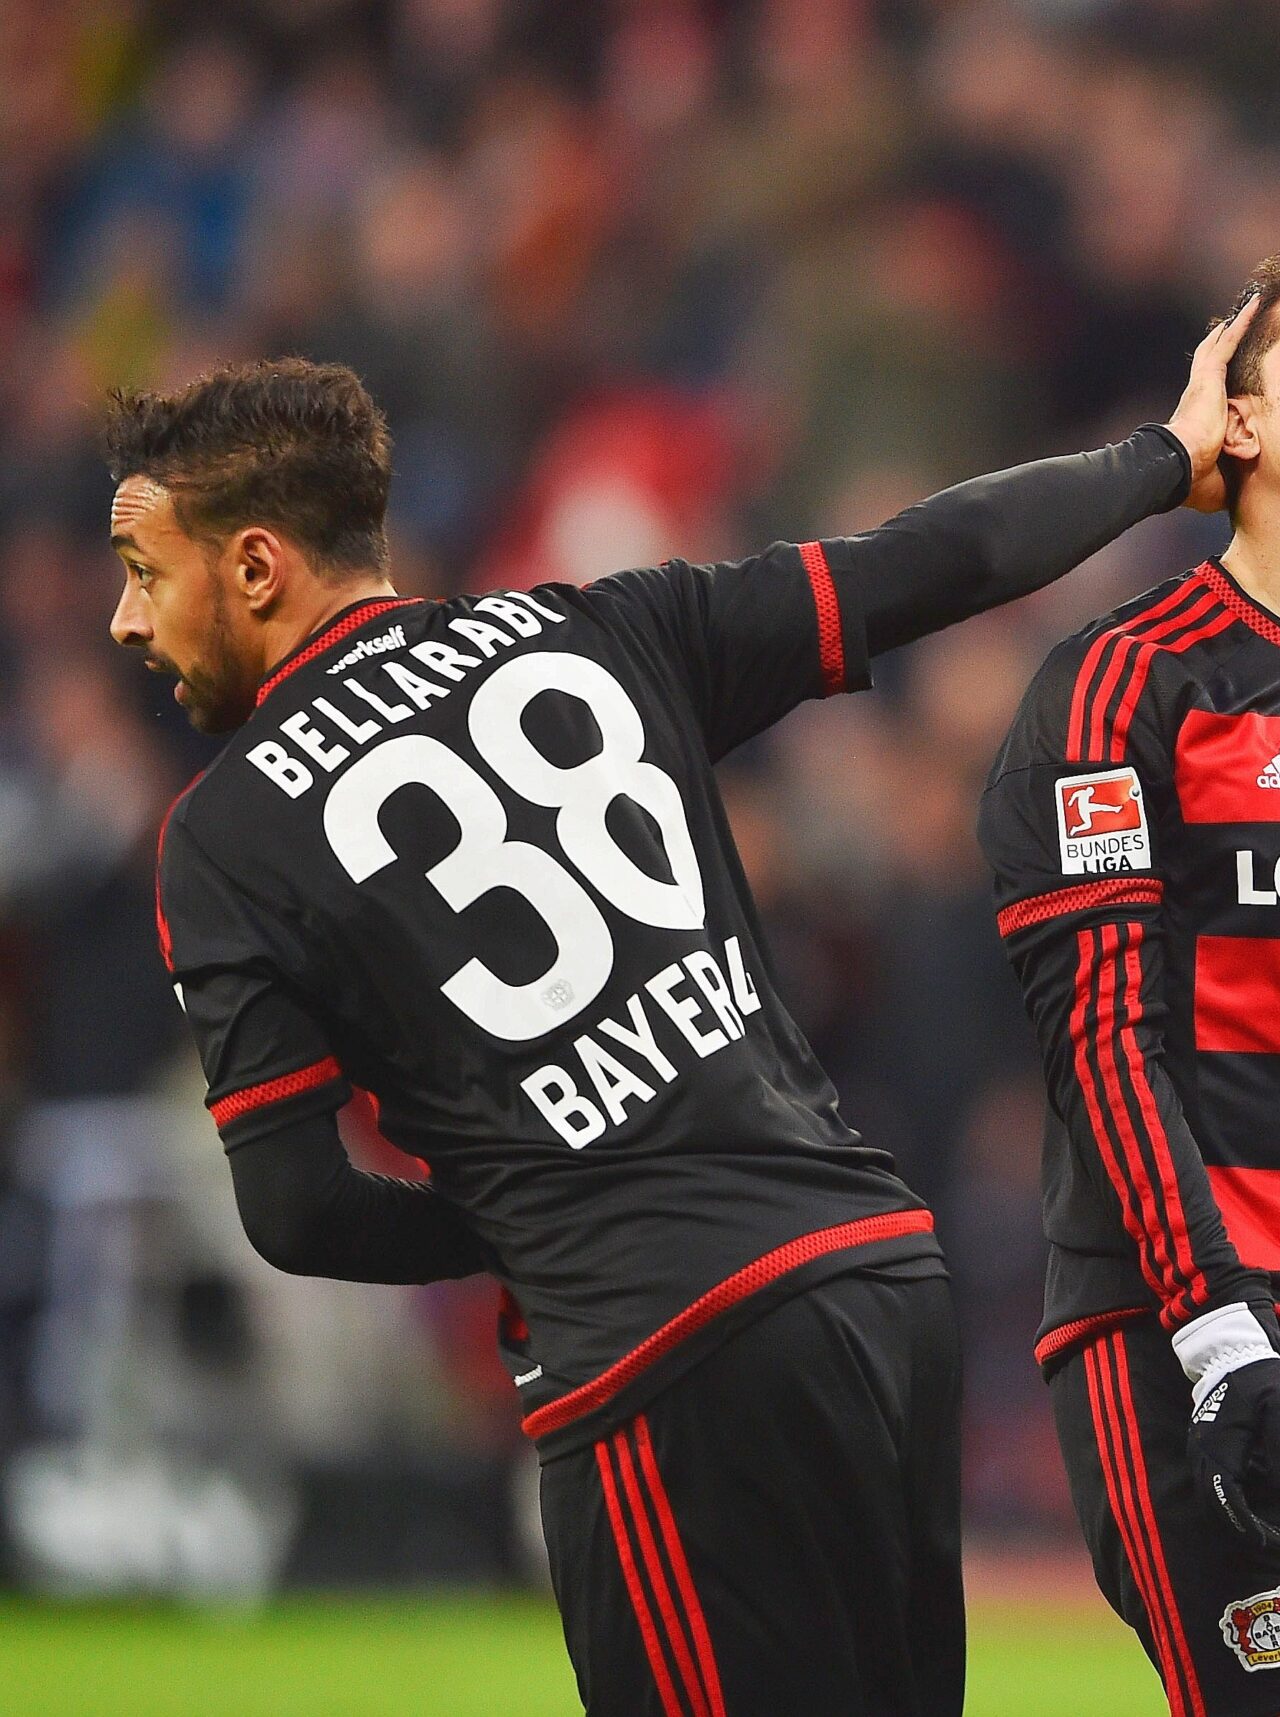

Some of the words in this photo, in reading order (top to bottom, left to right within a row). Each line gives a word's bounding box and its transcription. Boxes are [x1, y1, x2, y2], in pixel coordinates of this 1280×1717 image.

[326, 624, 407, 675] werkself
[245, 591, 567, 800] BELLARABI
[323, 651, 706, 1042] 38
[1066, 834, 1144, 858] BUNDES
[1083, 855, 1132, 874] LIGA
[1192, 1382, 1229, 1424] adidas
[1253, 1601, 1273, 1613] 1904
[1263, 1615, 1280, 1648] BAYER
